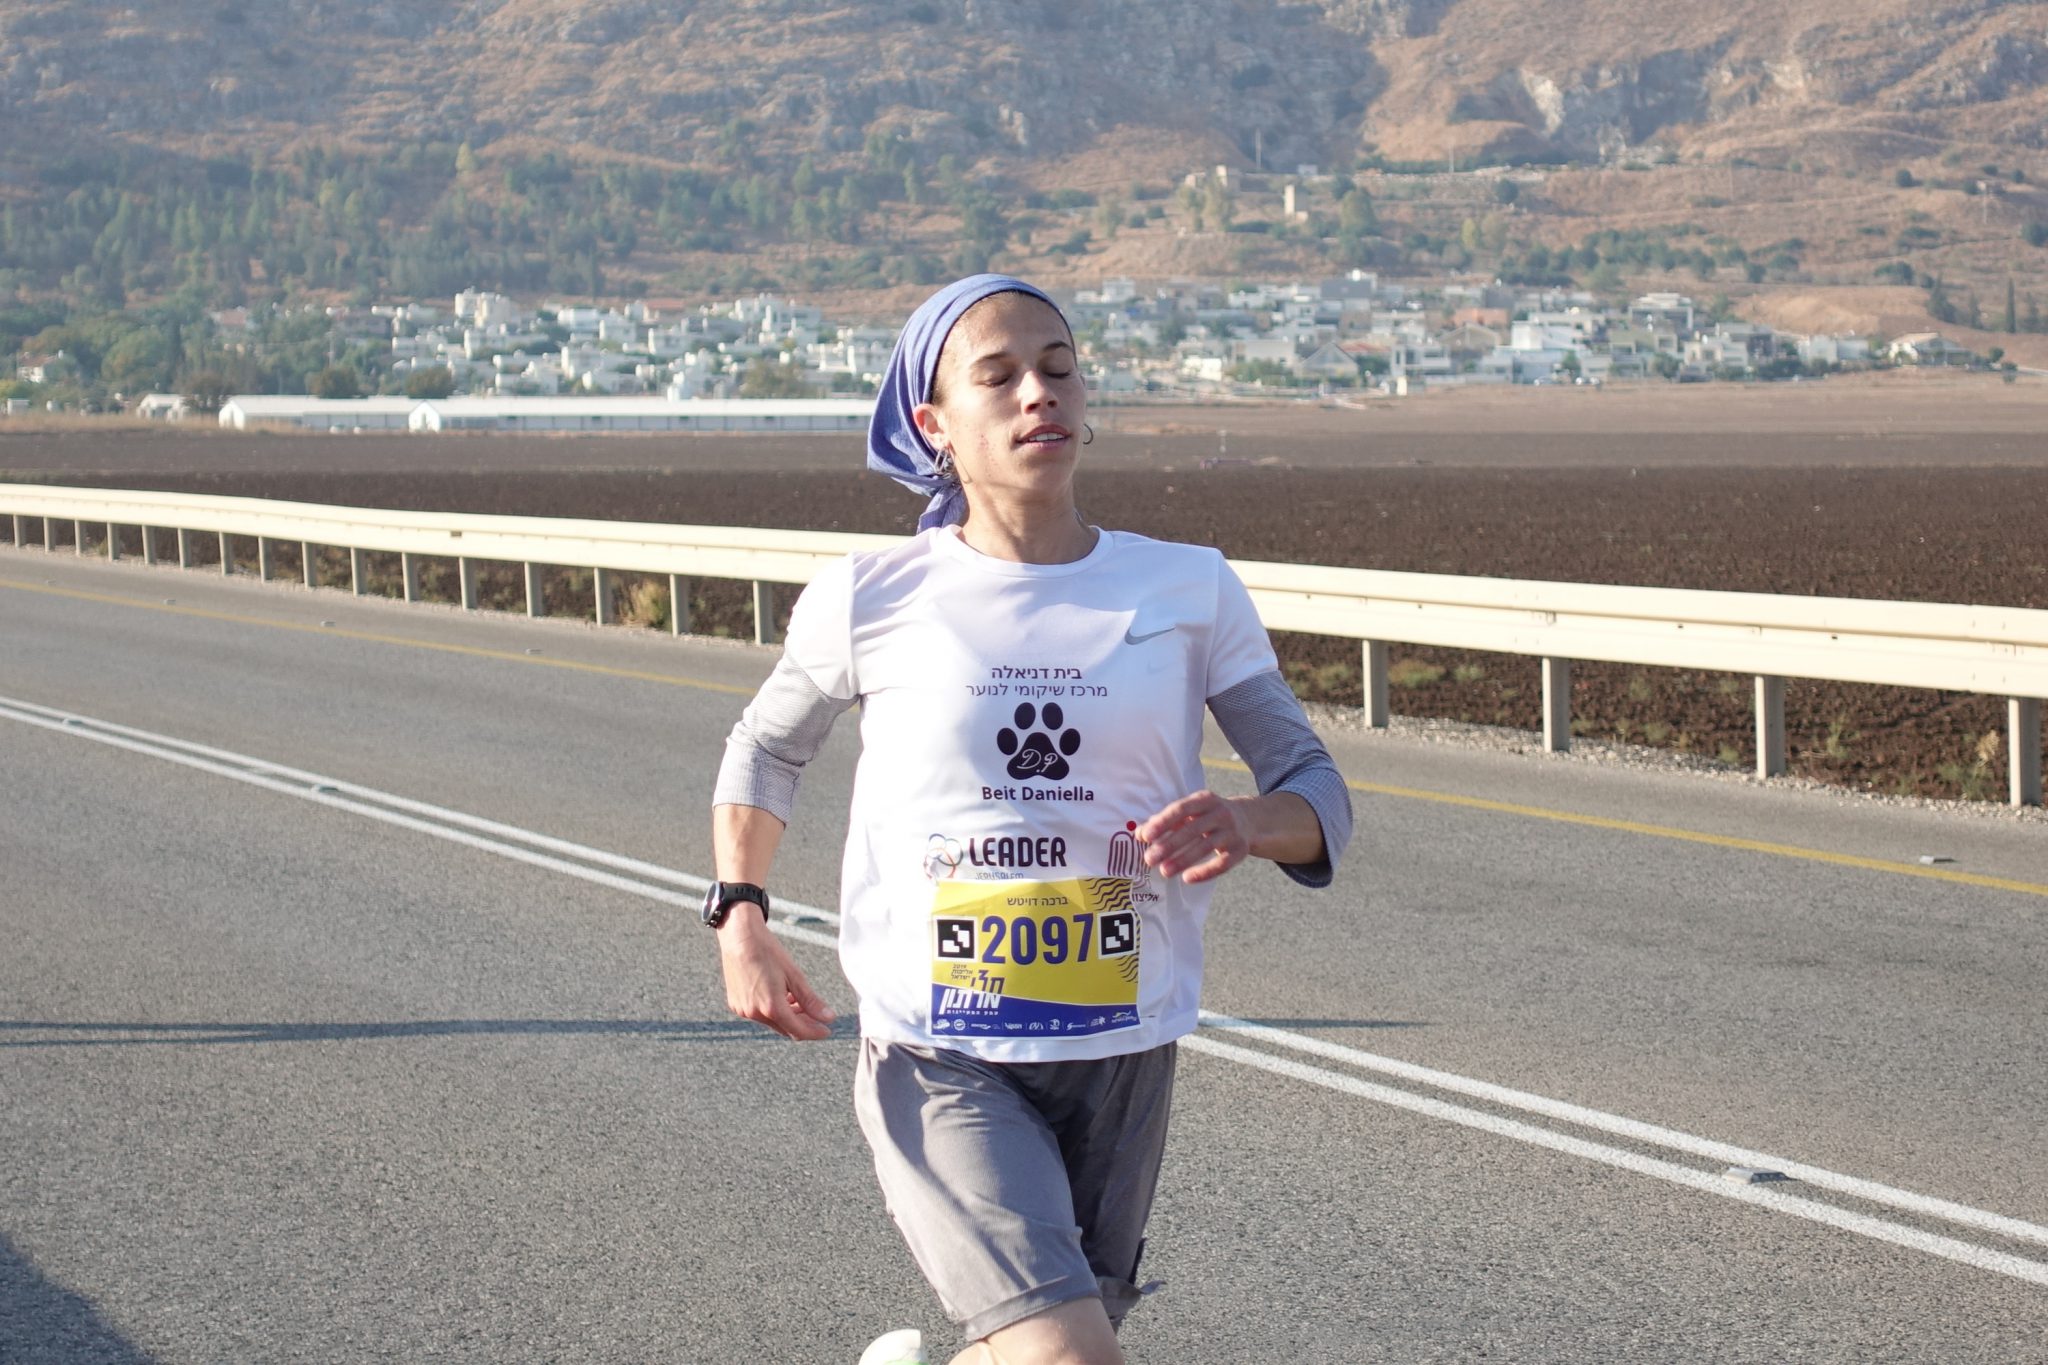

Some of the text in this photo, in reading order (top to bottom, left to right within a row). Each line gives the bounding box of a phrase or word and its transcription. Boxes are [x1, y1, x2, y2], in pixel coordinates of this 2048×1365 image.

[991, 665, 1082, 680] בית דניאלה
[966, 683, 1108, 699] מרכז שיקומי לנוער
[982, 786, 1094, 801] Beit Daniella
[969, 836, 1067, 867] LEADER
[1007, 896, 1069, 906] ברכה דויטש
[981, 912, 1094, 966] 2097
[938, 988, 1001, 1015] מרתון
